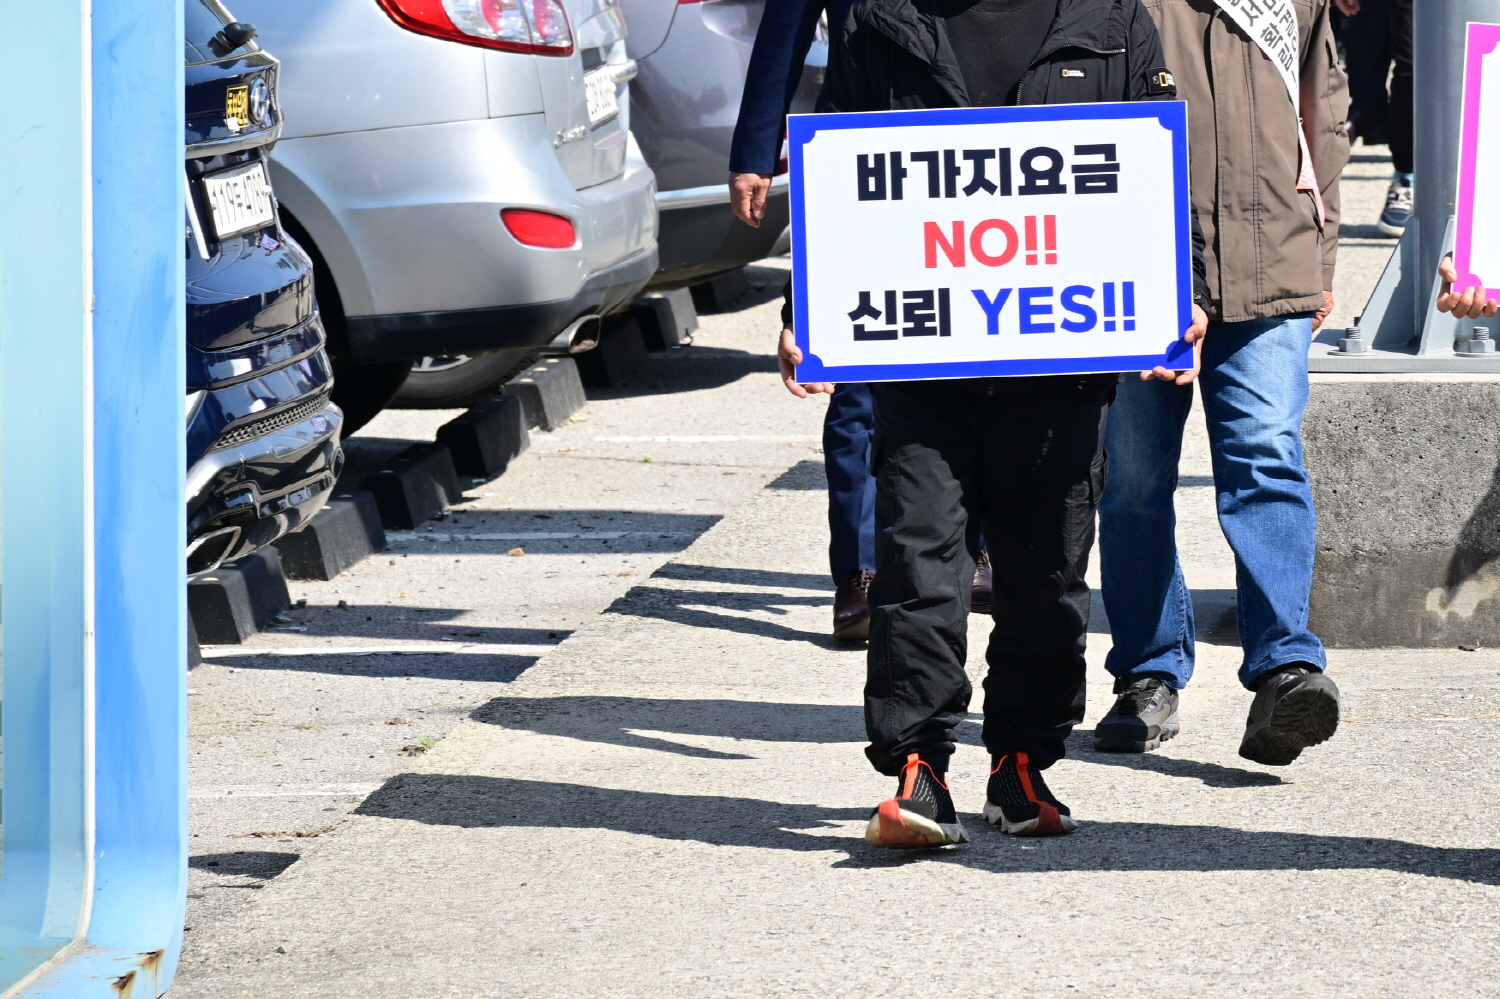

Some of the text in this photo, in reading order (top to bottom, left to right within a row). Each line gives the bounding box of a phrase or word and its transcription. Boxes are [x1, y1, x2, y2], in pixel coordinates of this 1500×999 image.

[856, 143, 1121, 202] 바가지요금
[923, 214, 1058, 269] NO!!
[847, 281, 1136, 342] 신뢰 YES!!
